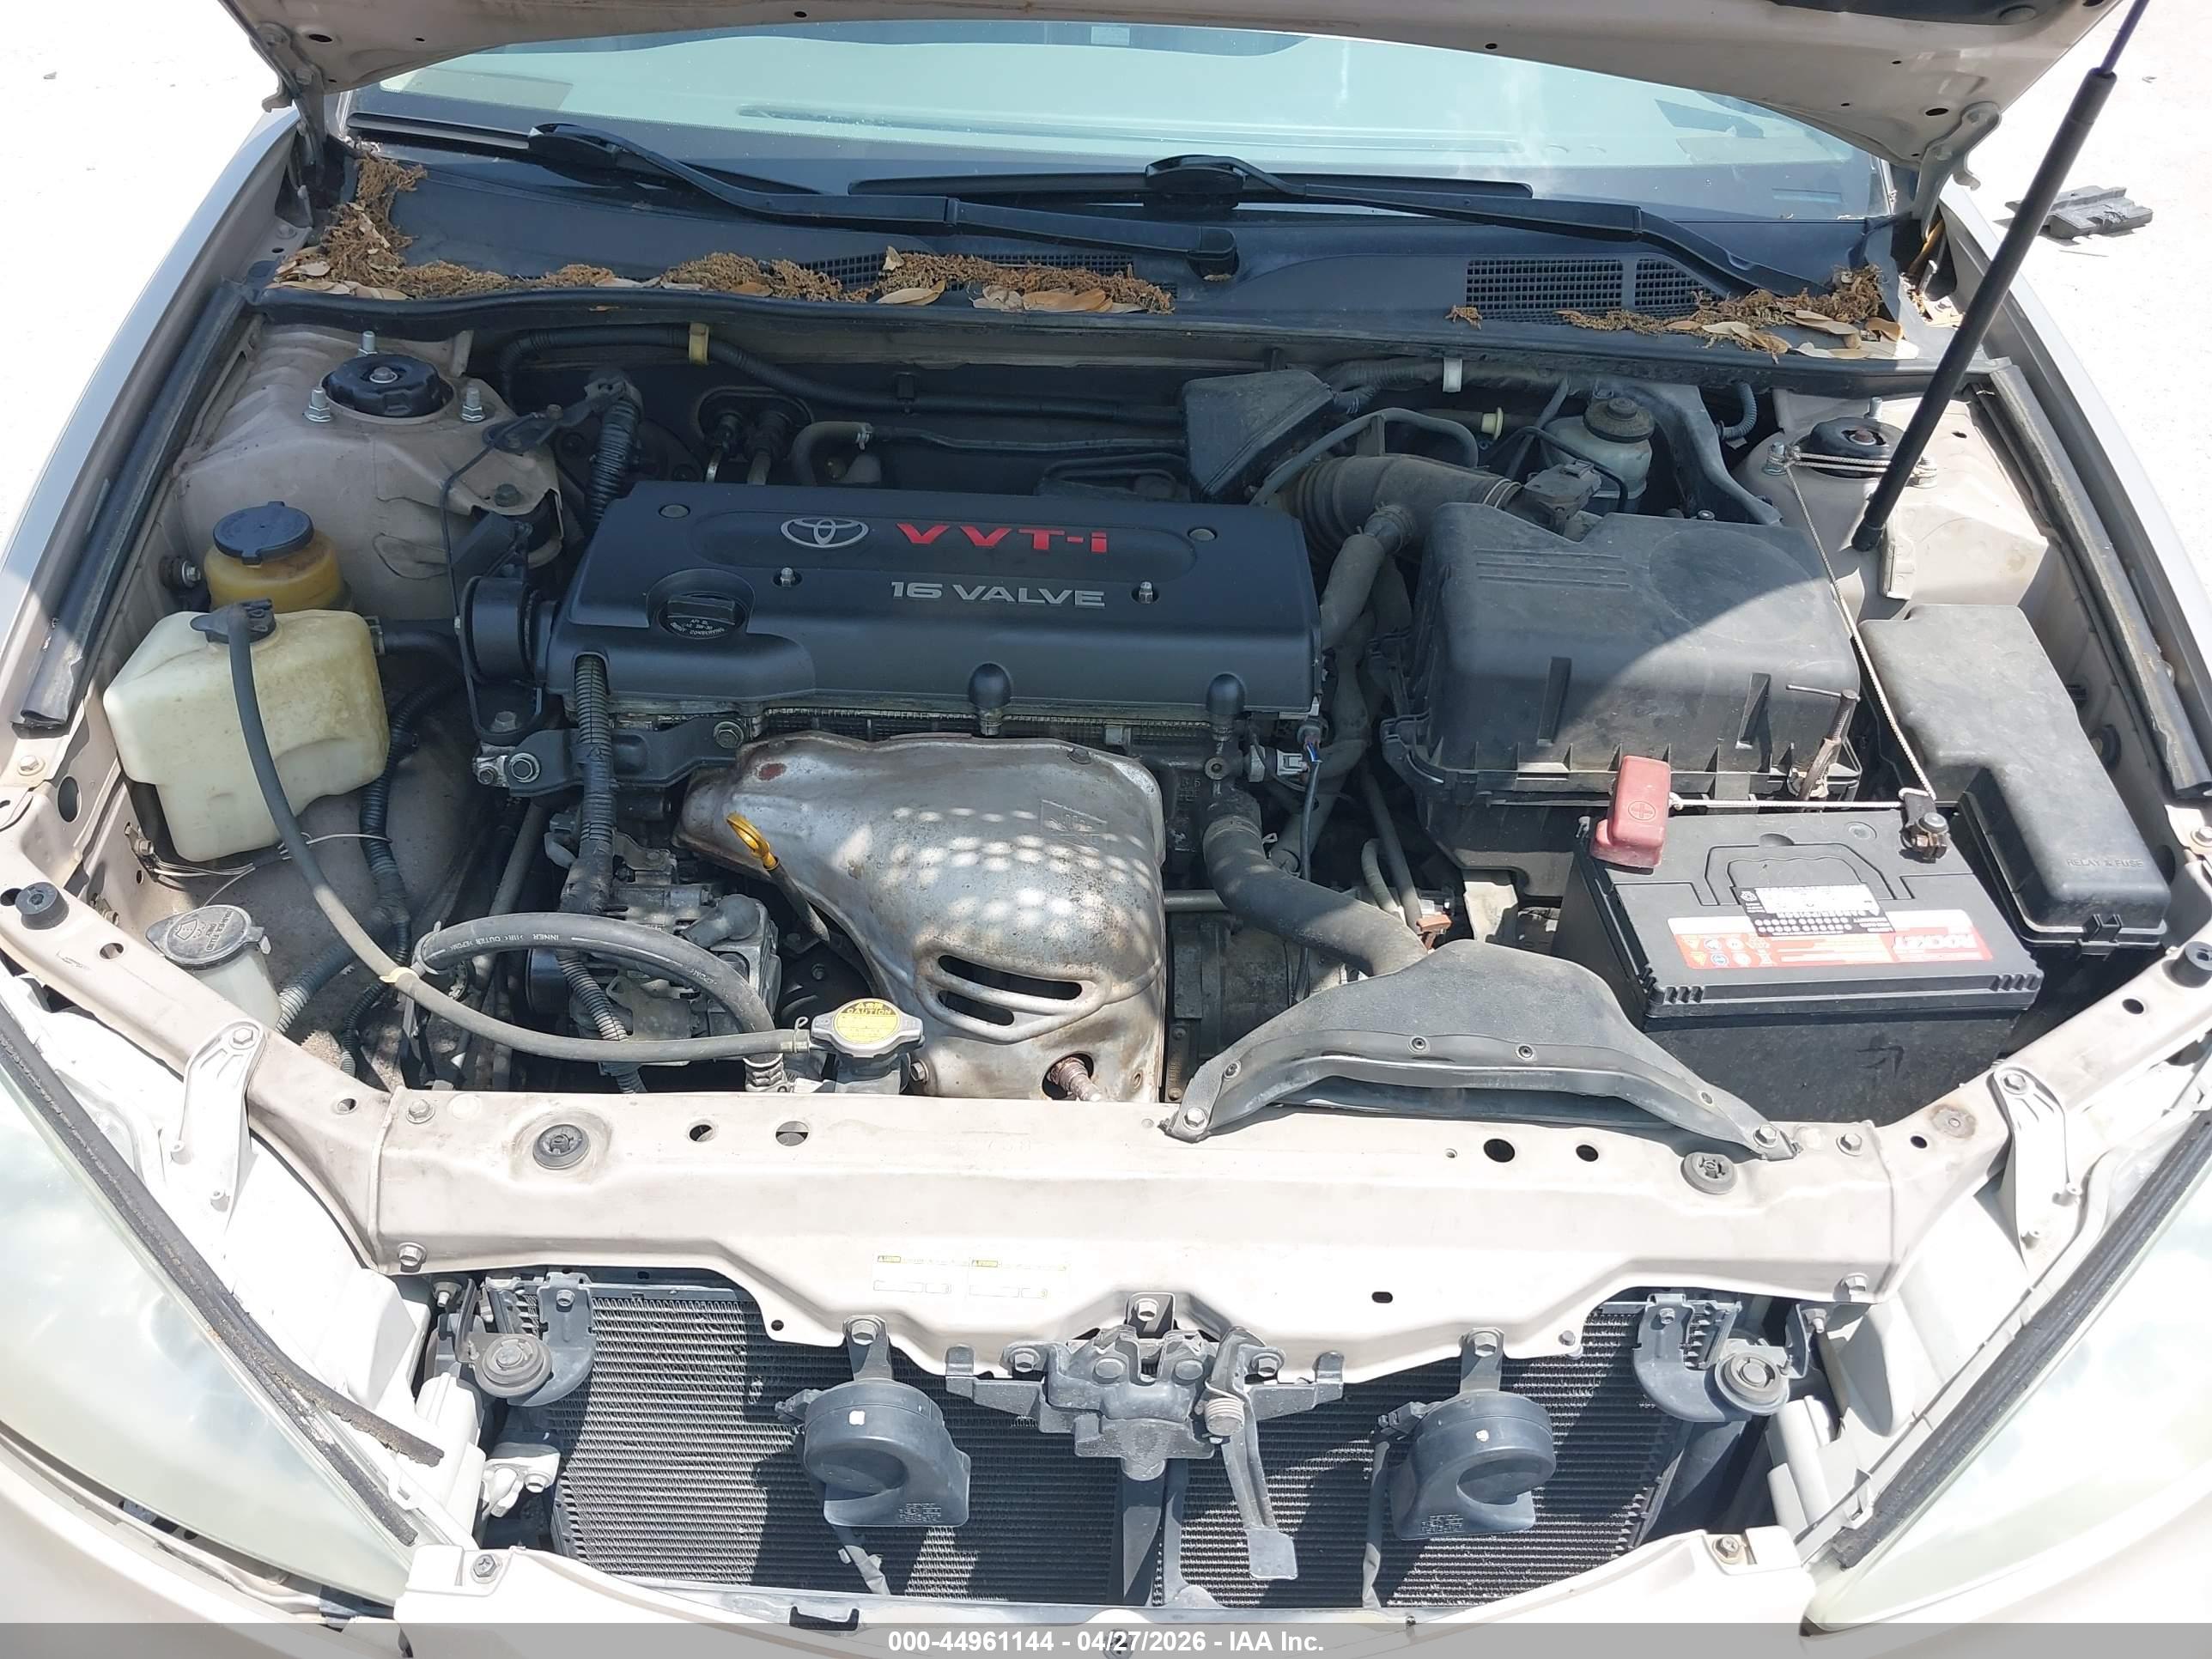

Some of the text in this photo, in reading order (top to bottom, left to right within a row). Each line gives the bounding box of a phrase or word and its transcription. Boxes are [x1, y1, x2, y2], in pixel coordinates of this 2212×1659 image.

[896, 521, 1108, 554] VVT-i
[890, 580, 1106, 608] 16 VALVE
[2115, 859, 2143, 867] FUSE
[475, 936, 501, 945] OUTER
